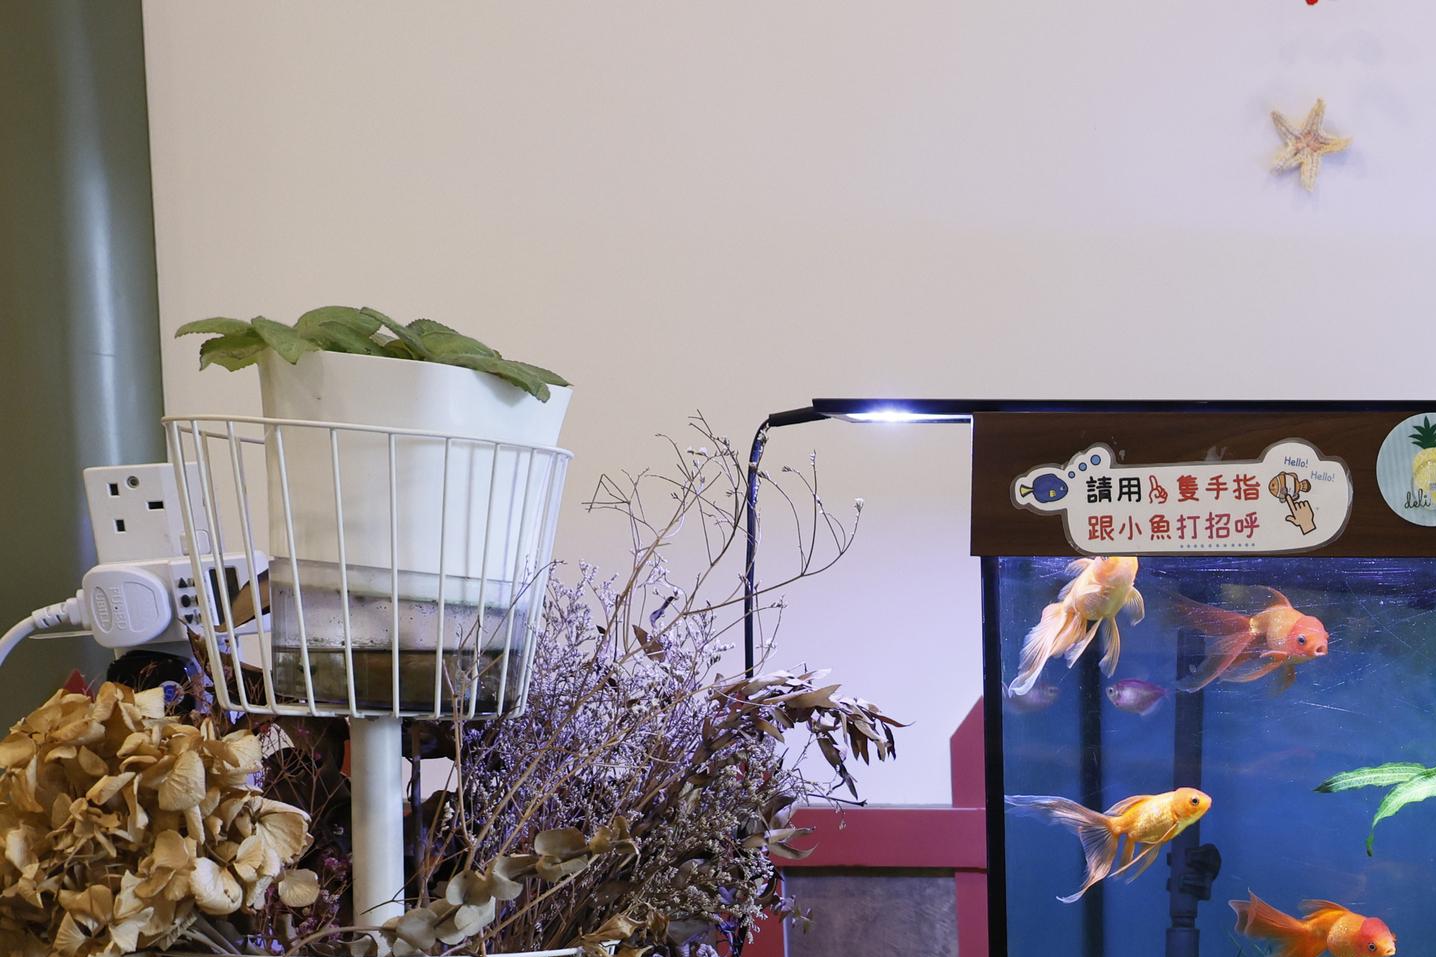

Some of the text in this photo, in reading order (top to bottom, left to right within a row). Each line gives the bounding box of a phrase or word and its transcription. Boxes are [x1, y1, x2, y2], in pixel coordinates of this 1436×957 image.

[1284, 456, 1309, 468] Hello!
[1310, 470, 1336, 483] Hello!
[1086, 474, 1260, 503] 請用 隻手指
[1088, 512, 1260, 541] 跟小魚打招呼
